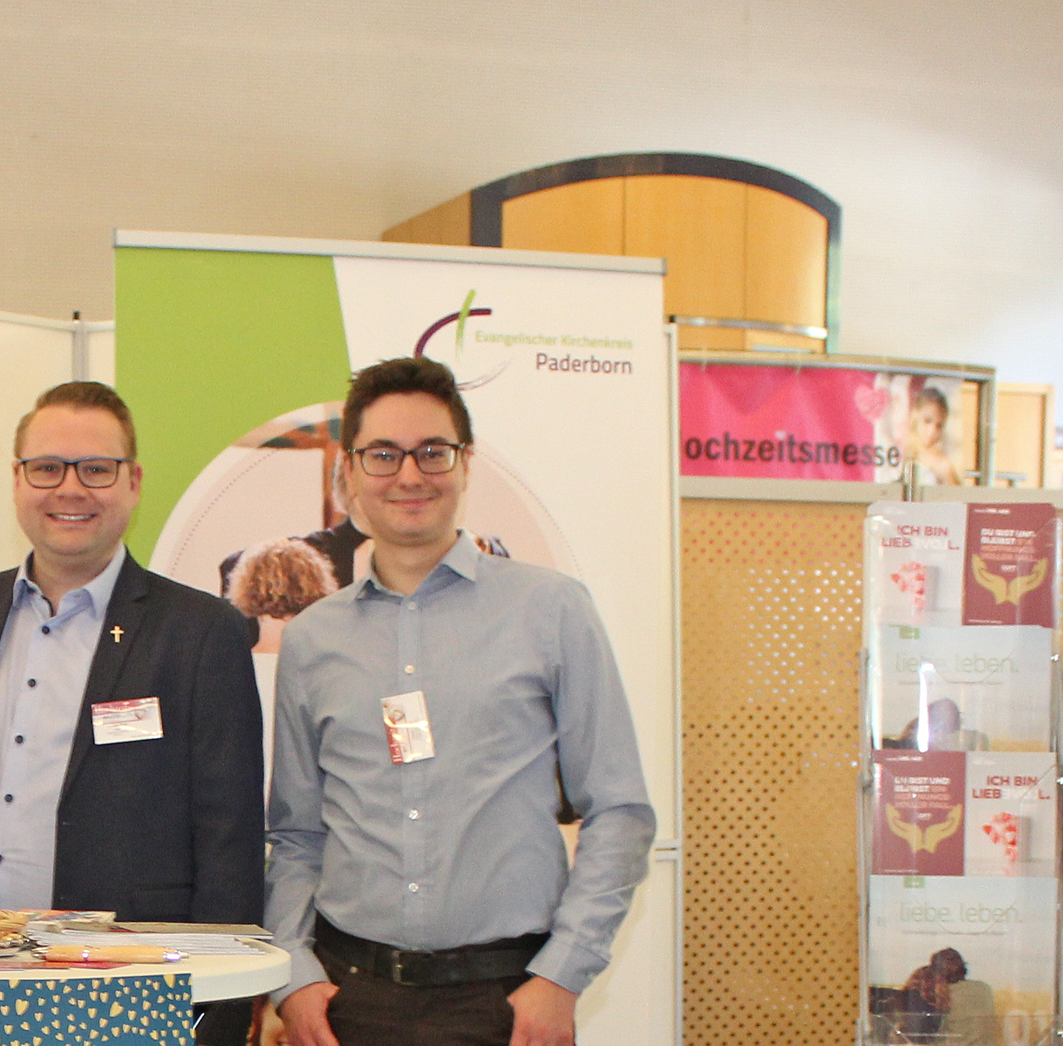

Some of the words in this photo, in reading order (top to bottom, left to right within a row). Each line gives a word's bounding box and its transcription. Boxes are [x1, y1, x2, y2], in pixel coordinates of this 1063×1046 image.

[475, 331, 558, 347] Evangelischer
[560, 334, 634, 350] Kirchenkreis
[536, 352, 633, 375] Paderborn
[684, 430, 902, 468] ochzeitsmesse
[897, 525, 920, 536] ICH
[923, 525, 949, 537] BIN
[987, 775, 1011, 787] ICH
[1013, 776, 1038, 787] BIN
